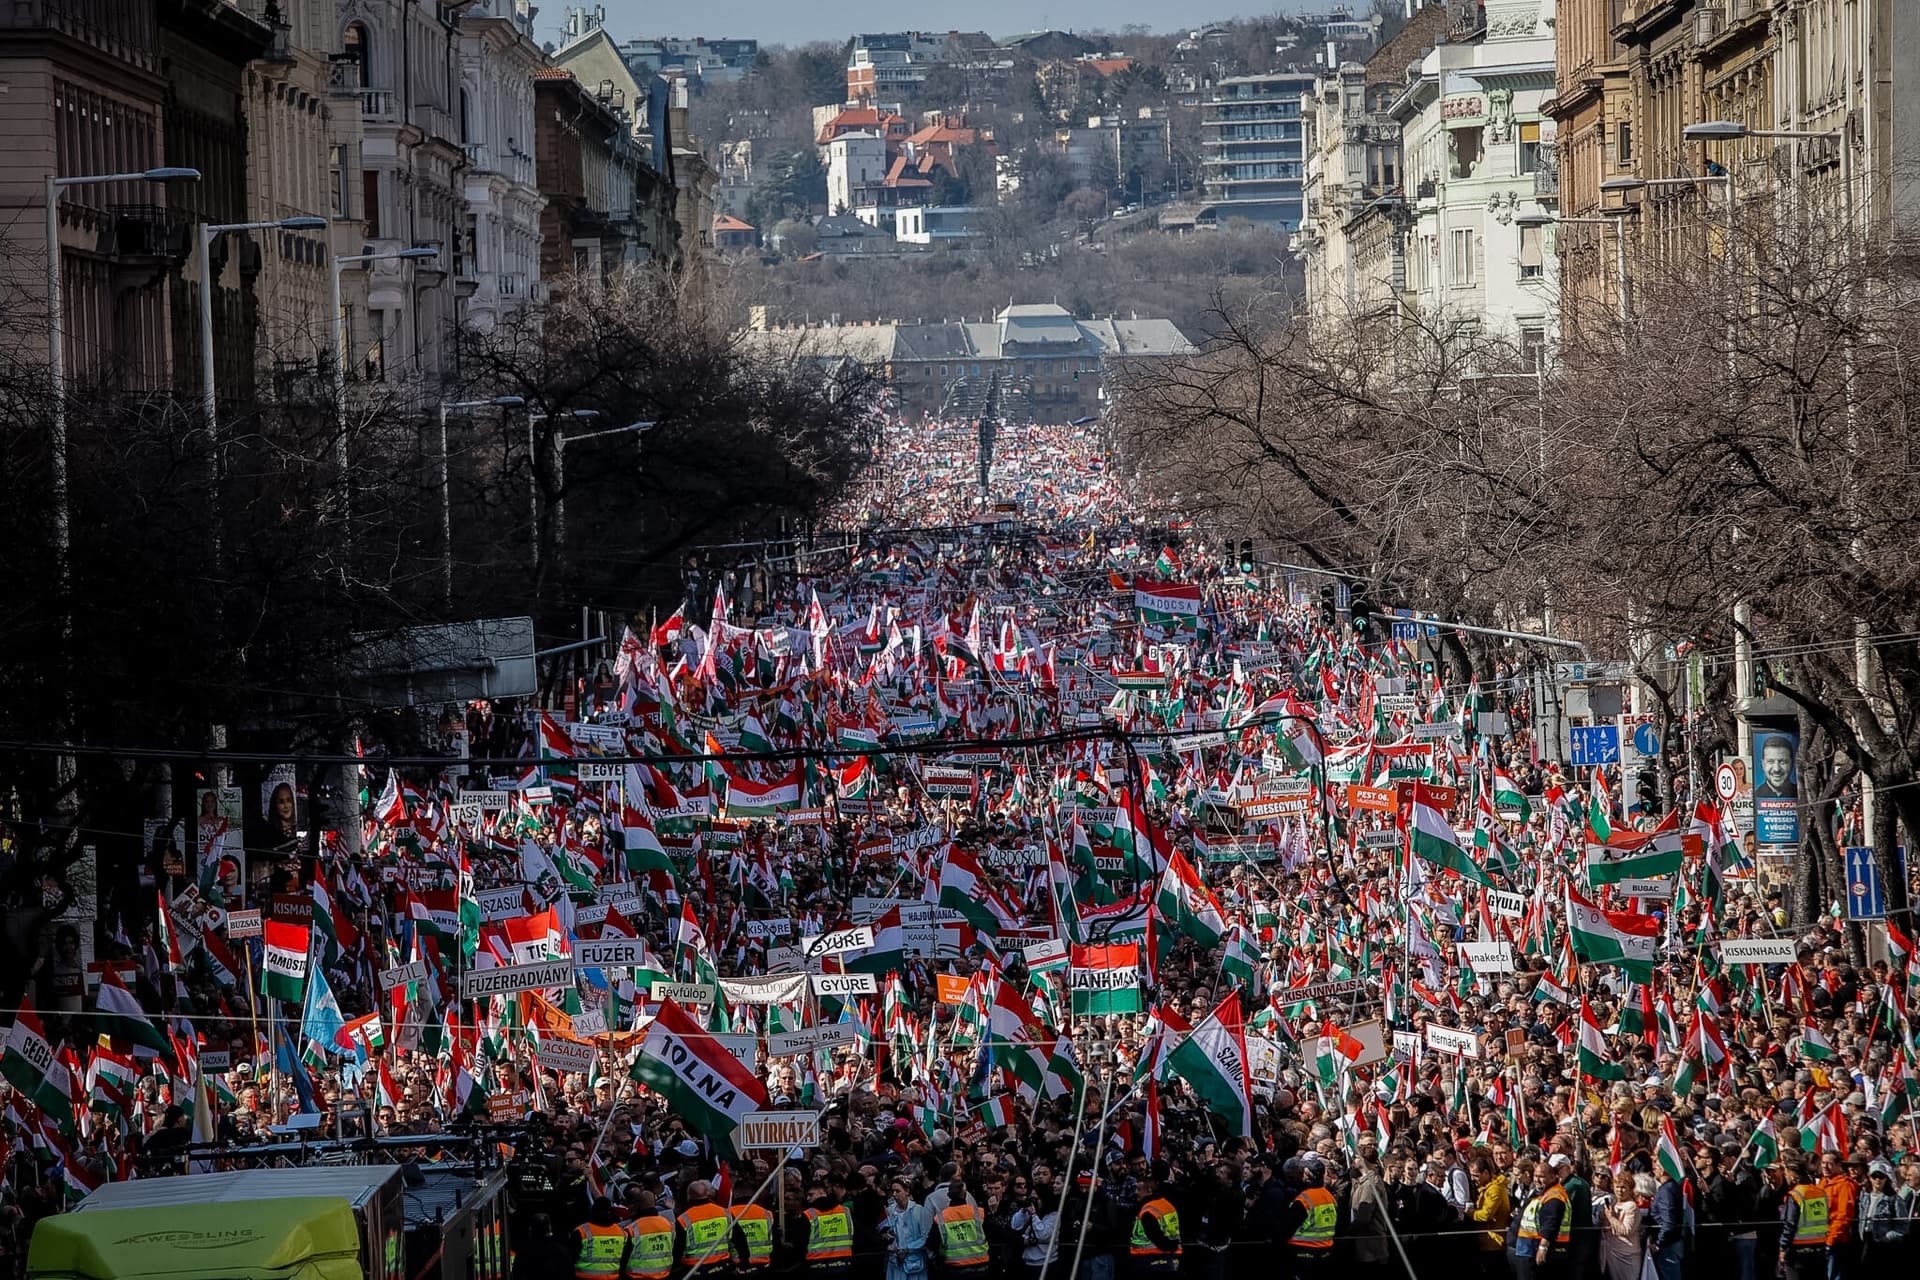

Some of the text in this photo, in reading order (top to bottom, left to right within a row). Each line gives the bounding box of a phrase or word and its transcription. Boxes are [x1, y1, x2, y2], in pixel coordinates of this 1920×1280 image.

[1181, 736, 1219, 748] KISKUMAJSA
[1721, 776, 1732, 790] 30
[1356, 790, 1376, 800] PEST
[452, 805, 479, 821] TASS
[842, 803, 885, 813] Debreen
[1246, 798, 1309, 816] VERESEGYHÁZ
[1631, 884, 1659, 893] BUGAC
[1487, 894, 1520, 912] GYULA
[229, 917, 260, 930] BUZSÁK
[581, 944, 635, 963] FÜZÉR
[1468, 951, 1509, 964] unakeszi
[1725, 945, 1792, 957] KISKUNHALAS
[468, 964, 568, 993] FÜZÉRRADVÁNY
[1284, 981, 1364, 1001] KISKUNMAJSA
[543, 1042, 590, 1060] ACSALAG
[661, 1034, 737, 1109] TOLNA
[745, 1116, 816, 1145] NYÍRKÁTA
